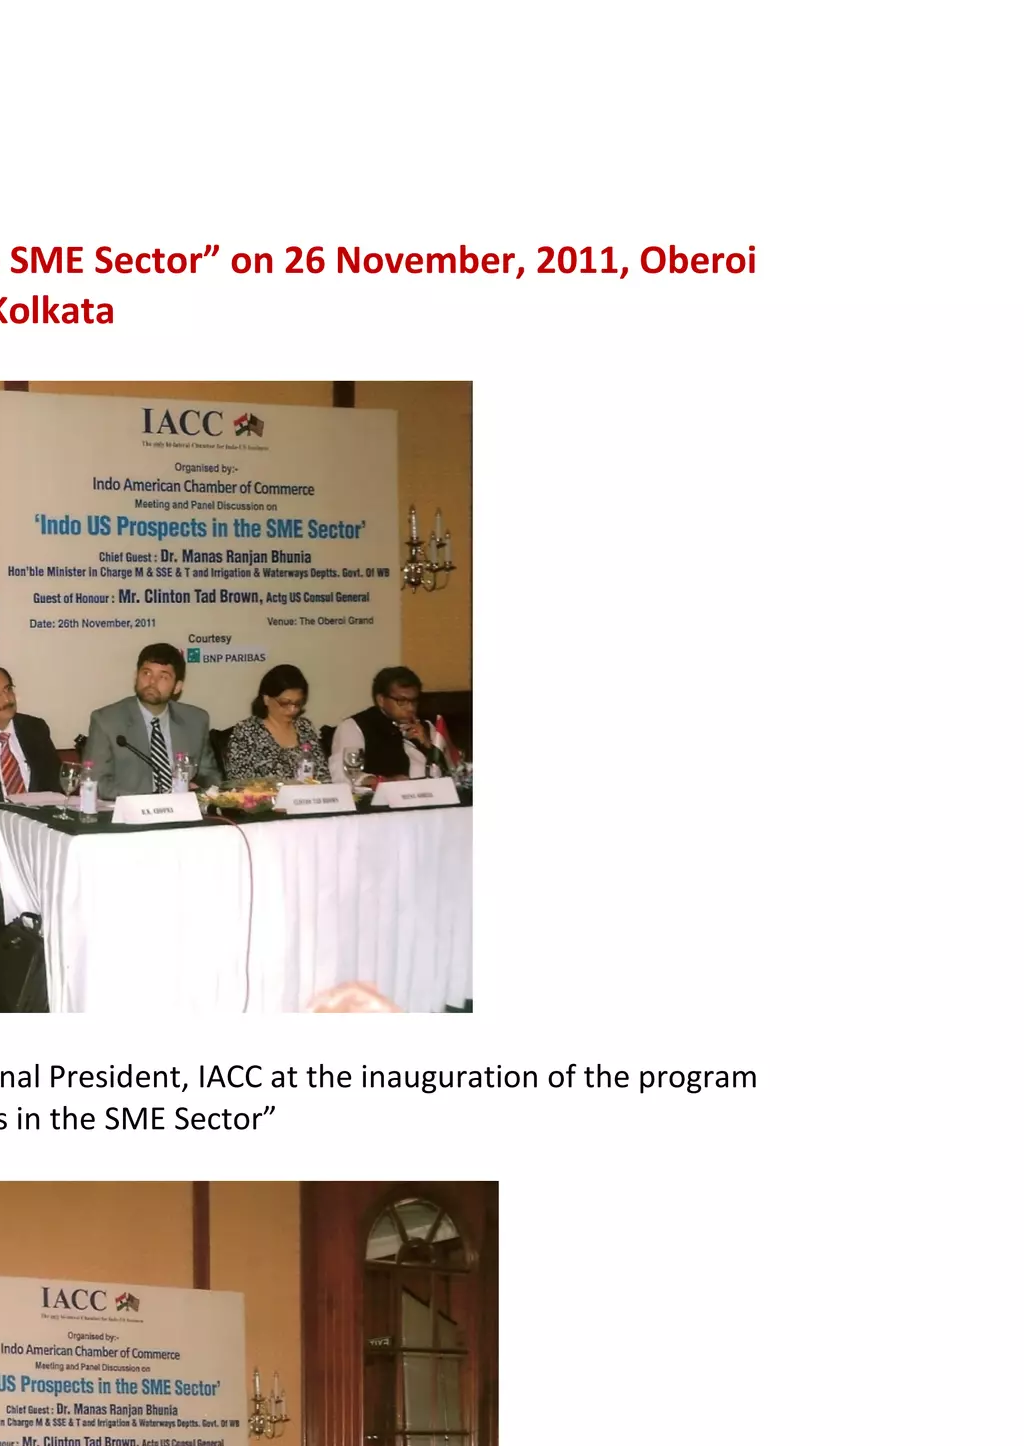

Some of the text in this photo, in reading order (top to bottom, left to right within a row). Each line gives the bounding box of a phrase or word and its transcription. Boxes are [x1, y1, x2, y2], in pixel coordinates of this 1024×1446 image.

[10, 245, 84, 275] SME
[94, 243, 220, 275] Sector”
[231, 252, 273, 275] on
[284, 245, 326, 275] 26
[337, 244, 525, 280] November,
[536, 245, 629, 280] 2011,
[640, 244, 756, 275] Oberoi
[141, 407, 224, 437] IACC
[174, 462, 220, 474] Organised
[92, 477, 315, 496] Indo American Chamber of Commerce
[135, 499, 277, 511] Meeting and Panel Discussion on
[87, 515, 111, 536] US
[116, 516, 207, 541] Prospects
[212, 518, 228, 536] in
[234, 518, 261, 538] the
[266, 518, 303, 538] SME
[99, 549, 312, 566] Chief Guest Dr. Manas Ranjan Bhunia
[47, 567, 86, 577] Minister
[89, 567, 98, 577] in
[100, 567, 133, 579] Charge
[156, 568, 173, 577] SSE
[193, 569, 208, 578] and
[211, 568, 251, 579] Irrigation
[263, 568, 309, 580] Waterways
[342, 568, 364, 578] Govt.
[377, 568, 390, 577] WB
[33, 589, 370, 605] Guest of Honour Mr. Clinton Tad Brown, Actg US Consul General
[29, 618, 156, 629] Date: 26th November, 2011
[267, 617, 297, 626] Venue:
[299, 617, 315, 625] The
[348, 616, 374, 625] Grand
[188, 634, 232, 645] Courtesy
[203, 654, 266, 663] BNP PARIBAS
[41, 1286, 108, 1311] IACC
[21, 1375, 94, 1397] Prospects
[98, 1378, 111, 1394] in
[116, 1378, 138, 1394] the
[142, 1379, 172, 1395] SME
